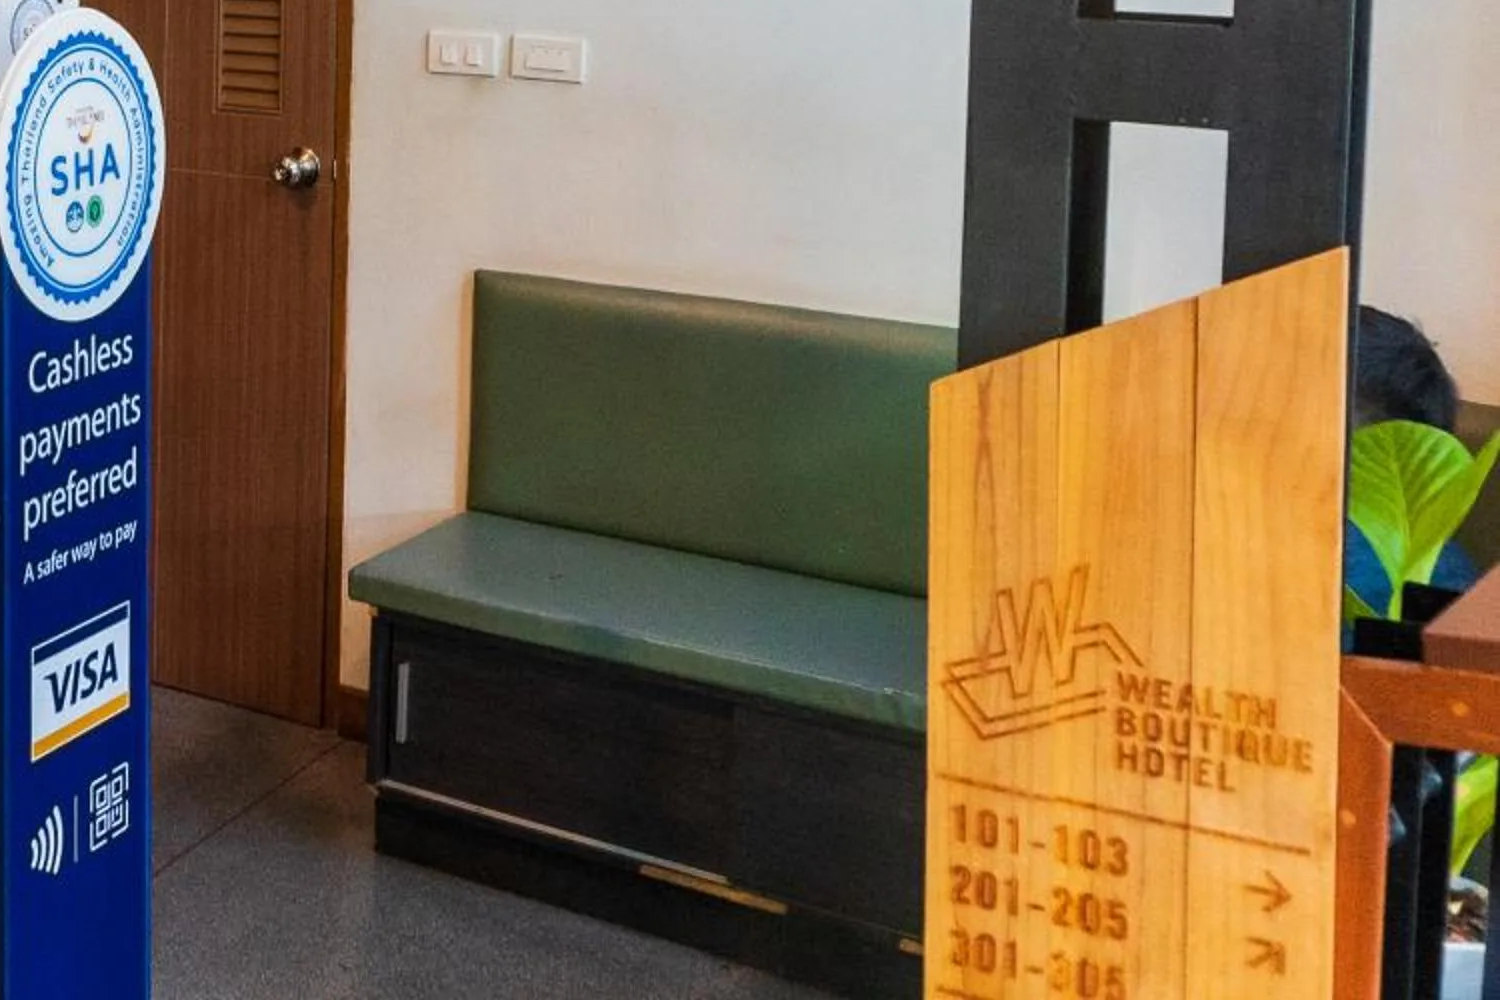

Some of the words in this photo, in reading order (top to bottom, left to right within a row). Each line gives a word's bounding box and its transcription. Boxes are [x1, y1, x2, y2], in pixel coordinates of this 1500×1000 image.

[47, 60, 84, 94] Safety
[50, 143, 122, 197] SHA
[28, 333, 134, 394] Cashless
[19, 393, 142, 477] payments
[23, 445, 138, 543] preferred
[23, 561, 35, 585] A
[36, 549, 70, 580] safer
[71, 538, 97, 562] way
[99, 531, 113, 550] to
[114, 520, 137, 548] pay
[44, 641, 119, 715] VISA
[1115, 671, 1276, 730] WEALTH
[1115, 706, 1314, 775] BOUTIQUE
[1115, 741, 1237, 793] HOTEL
[950, 804, 1130, 877] 101-103
[950, 865, 1129, 941] 201-205
[949, 927, 1127, 1000] 301-305
